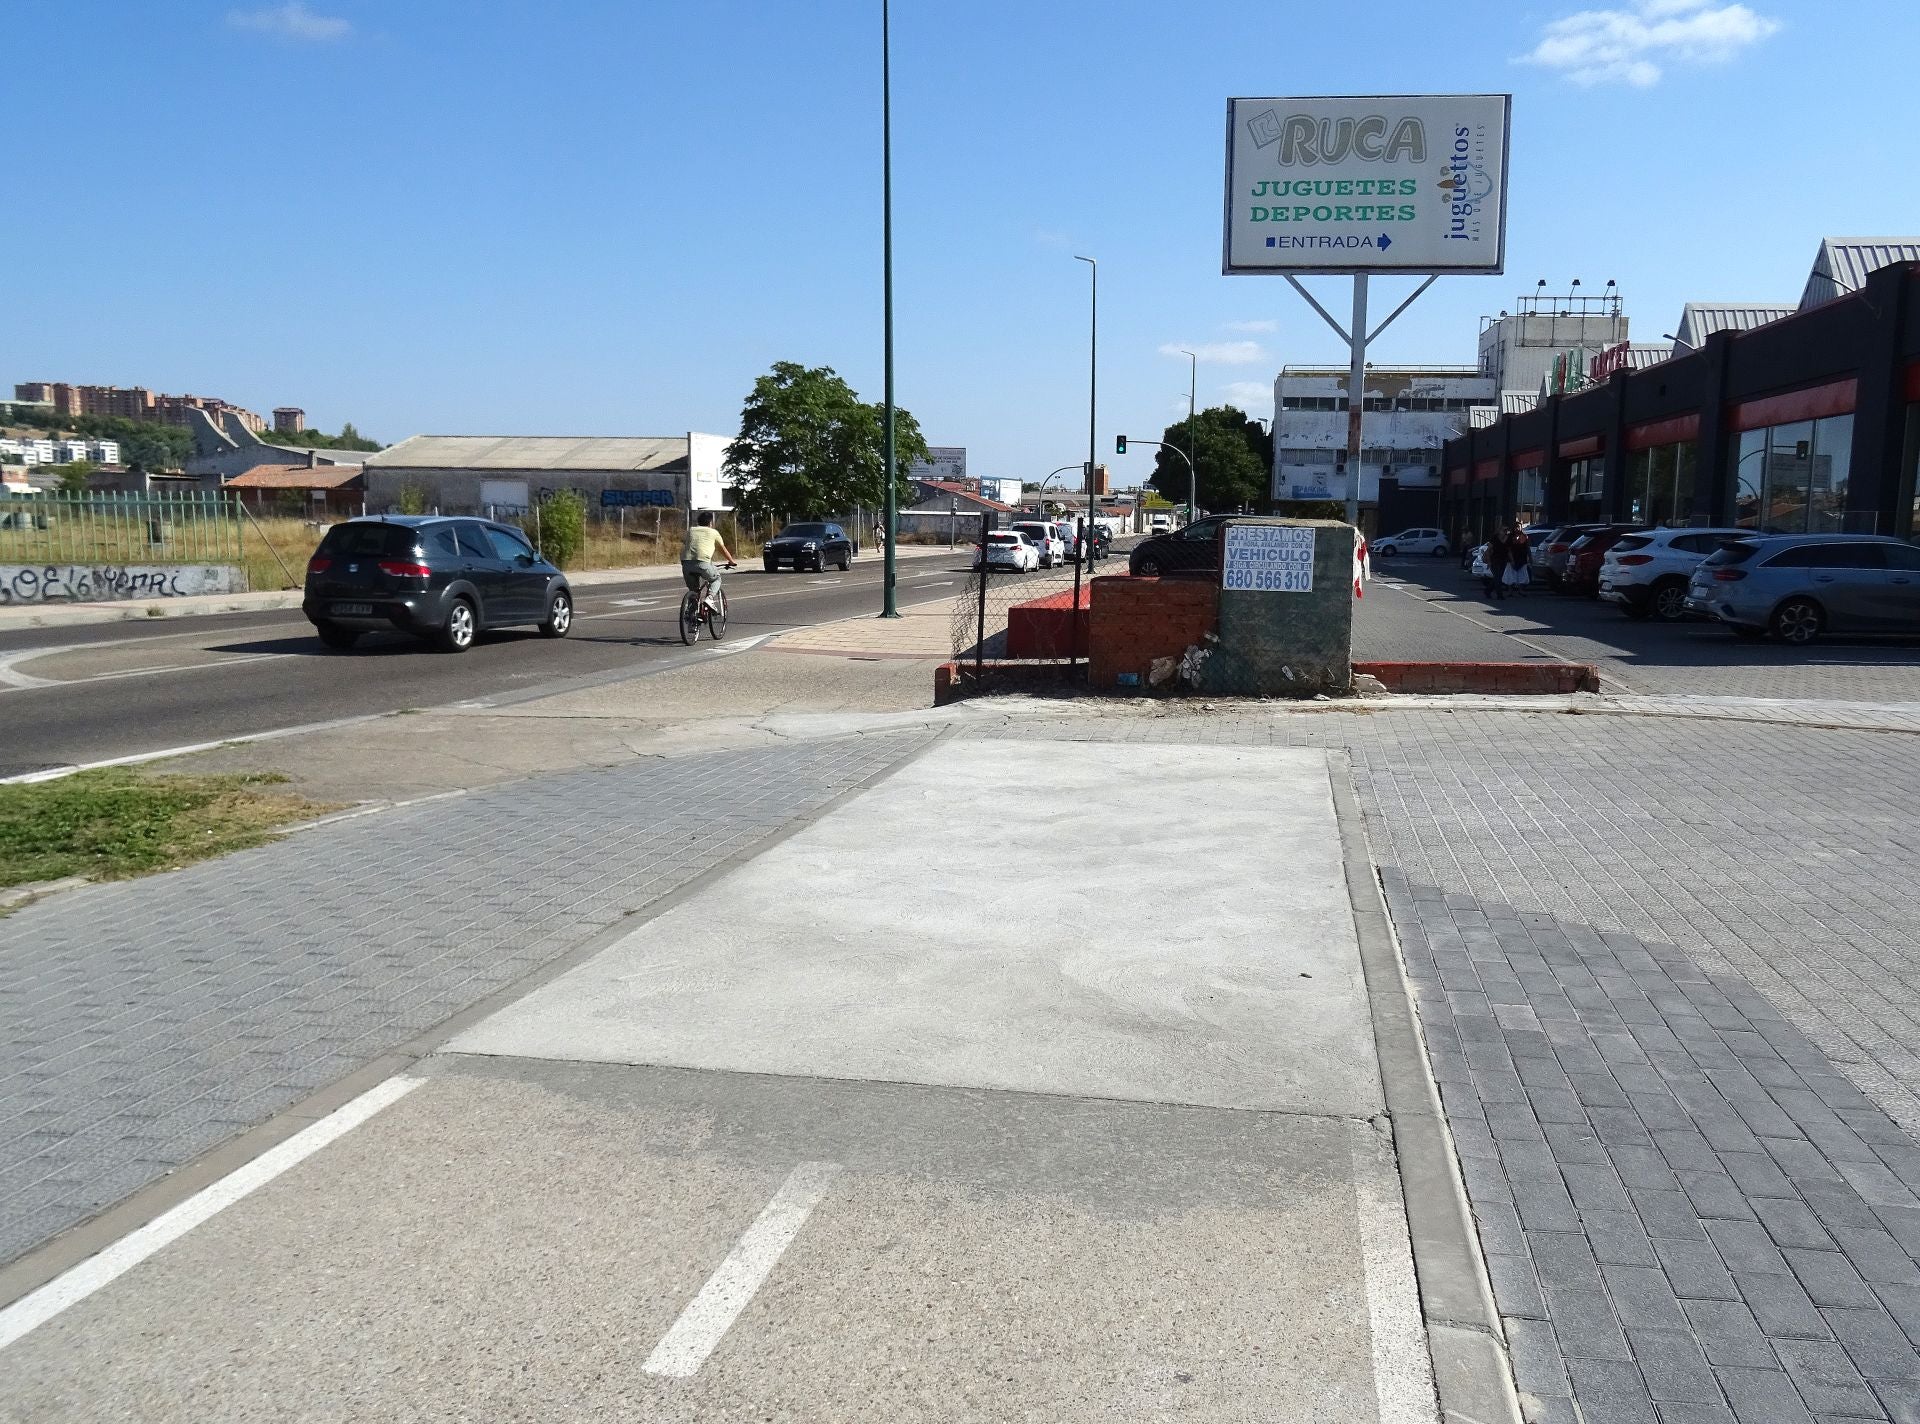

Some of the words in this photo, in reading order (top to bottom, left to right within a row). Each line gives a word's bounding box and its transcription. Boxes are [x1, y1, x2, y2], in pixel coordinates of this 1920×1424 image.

[1278, 114, 1427, 167] RUCA
[1474, 125, 1486, 184] JUGUETES
[1251, 179, 1417, 197] JUGUETES
[1444, 126, 1473, 241] juguettos
[1249, 204, 1416, 223] DEPORTES
[1278, 235, 1373, 249] ENTRADA
[1228, 528, 1313, 542] PRESTAMOS
[1228, 548, 1311, 562] VEHICULO
[1250, 562, 1286, 570] CIRCULANDO
[1226, 570, 1253, 588] 680
[1255, 570, 1282, 590] 566
[1284, 571, 1310, 590] 310
